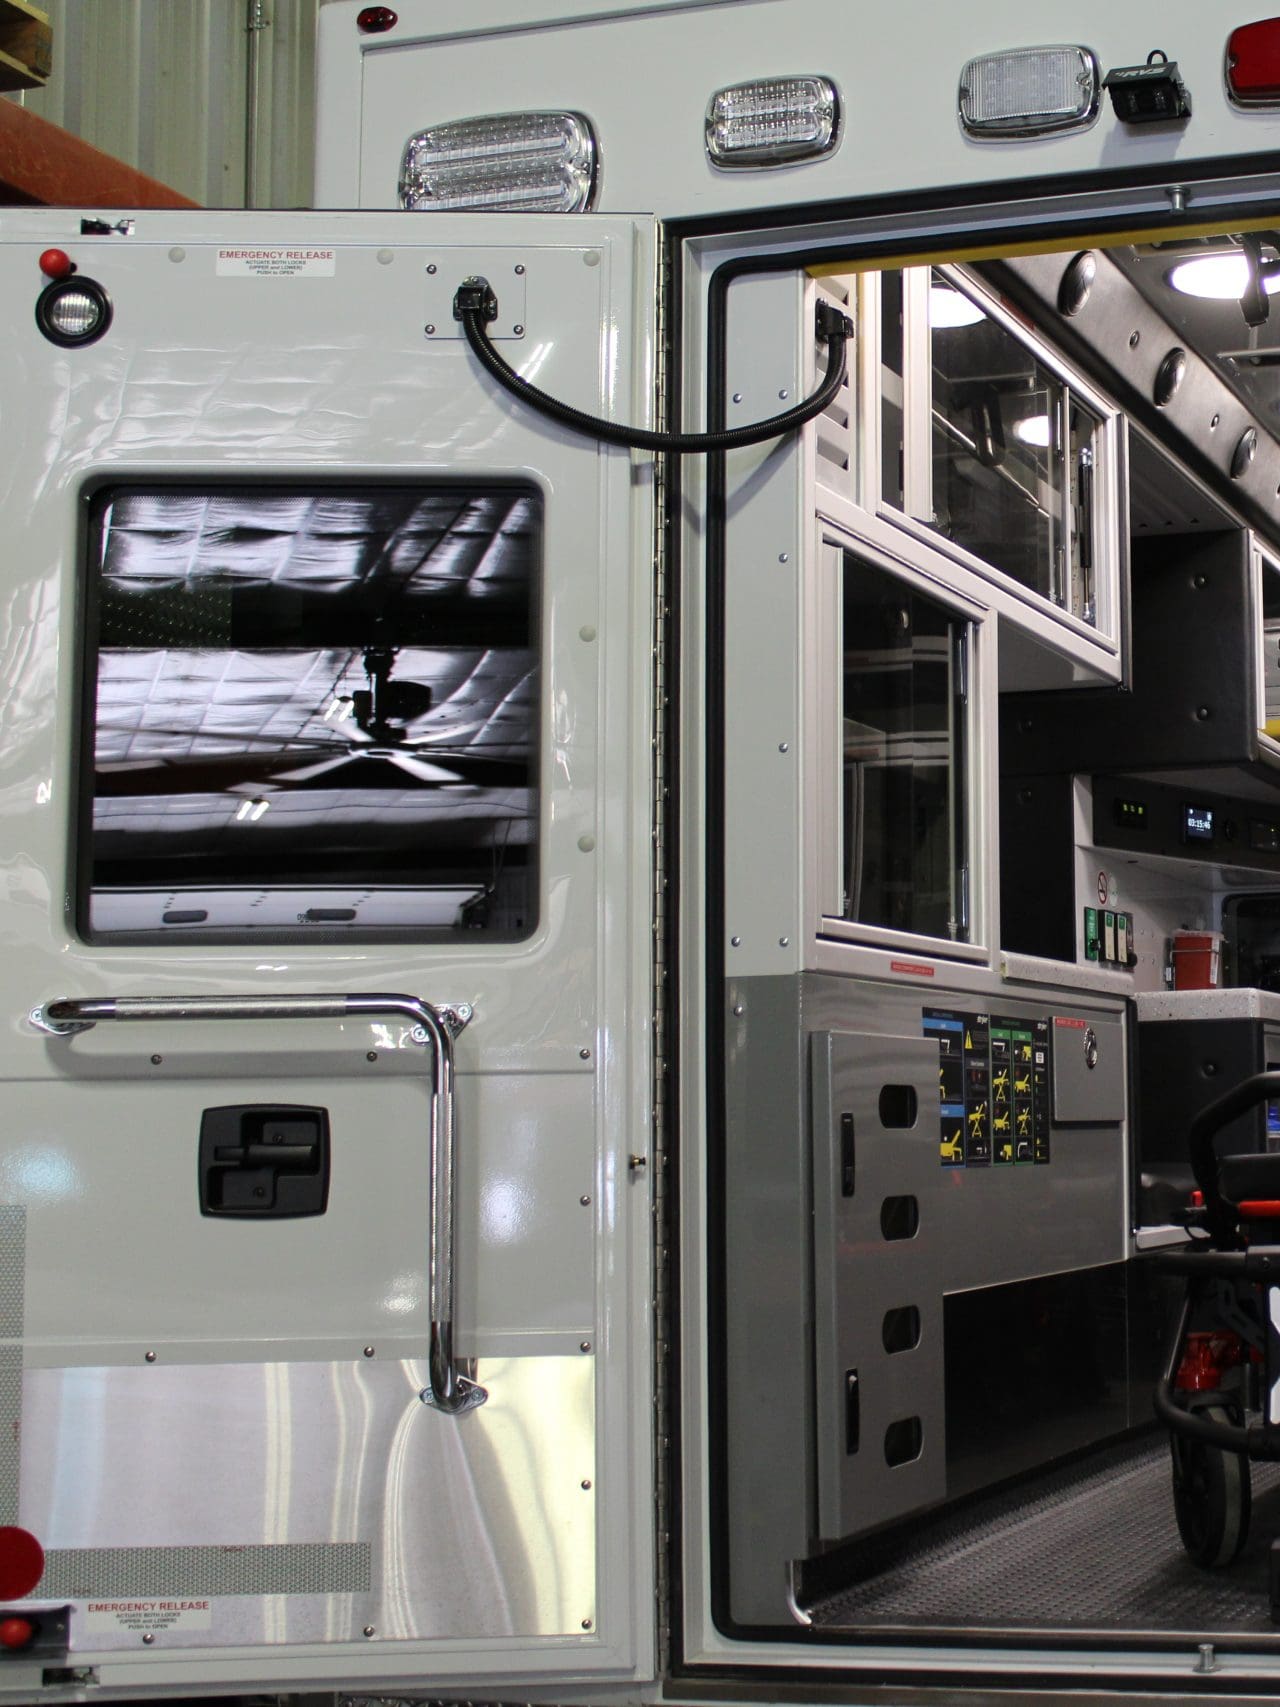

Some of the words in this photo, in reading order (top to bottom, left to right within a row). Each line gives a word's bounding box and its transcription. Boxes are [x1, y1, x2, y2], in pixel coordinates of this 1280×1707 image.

[219, 251, 283, 259] EMERGENCY
[286, 251, 333, 259] RELEASE
[88, 1602, 156, 1612] EMERGENCY
[159, 1601, 209, 1611] RELEASE
